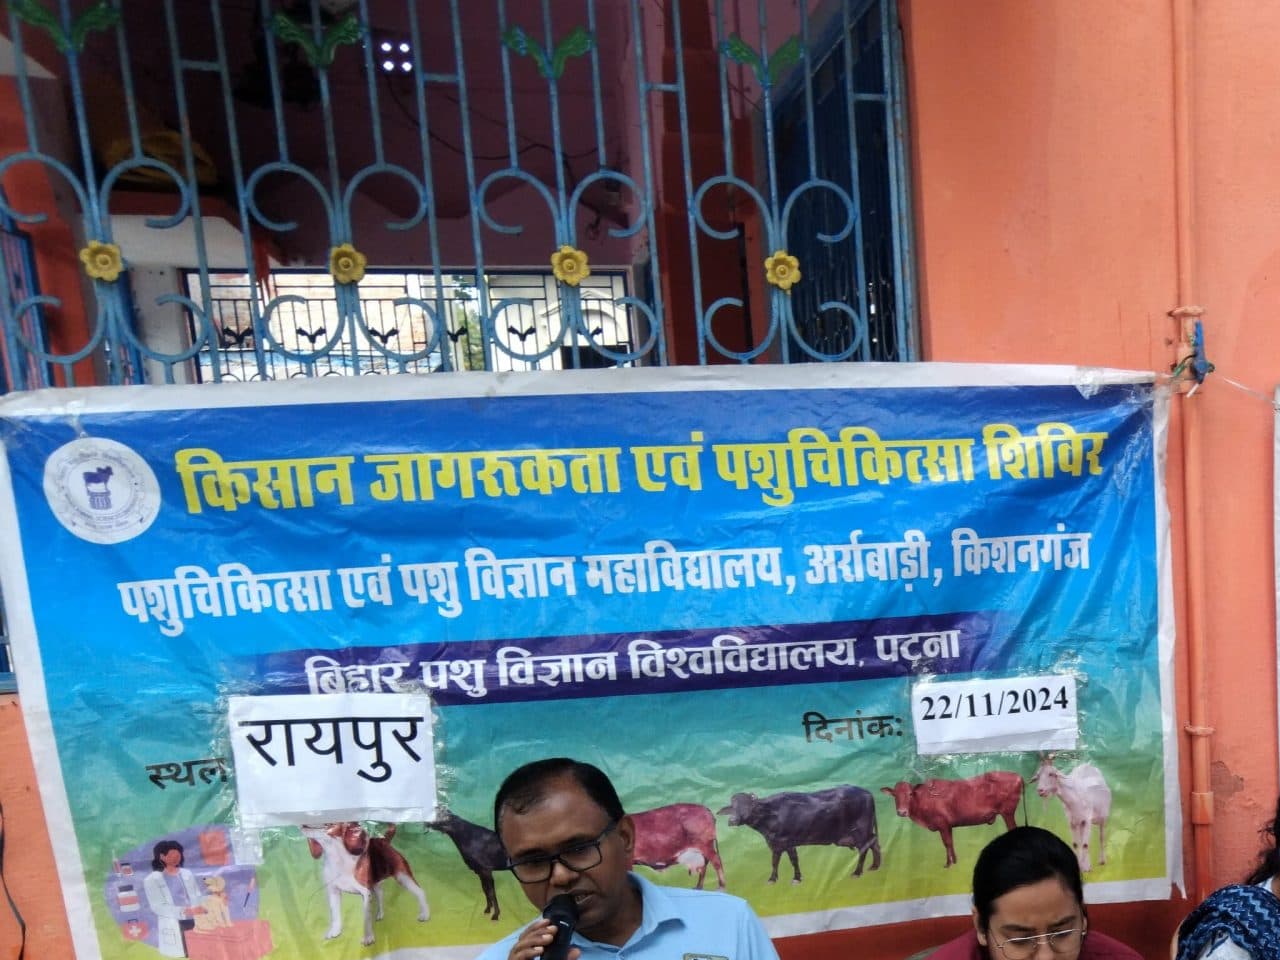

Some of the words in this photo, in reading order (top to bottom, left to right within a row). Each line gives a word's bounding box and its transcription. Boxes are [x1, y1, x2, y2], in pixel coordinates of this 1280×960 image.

[175, 448, 353, 514] किसान
[363, 444, 620, 503] जागरूकता
[631, 431, 703, 493] एवं
[713, 426, 975, 507] पशुचिकित्सा
[983, 422, 1108, 480] शिविर
[118, 562, 333, 638] पशुचिकित्सा
[337, 553, 392, 607] एवं
[400, 560, 462, 618] पशु
[465, 547, 577, 602] विज्ञान
[582, 539, 796, 596] महाविद्यालय,
[952, 522, 1092, 578] किशनगंज
[304, 655, 410, 695] बिहार
[419, 659, 487, 698] पशु
[496, 646, 618, 688] विज्ञान
[874, 630, 961, 663] पटना
[920, 686, 1069, 720] 22/11/2024
[238, 716, 424, 783] रायपुर
